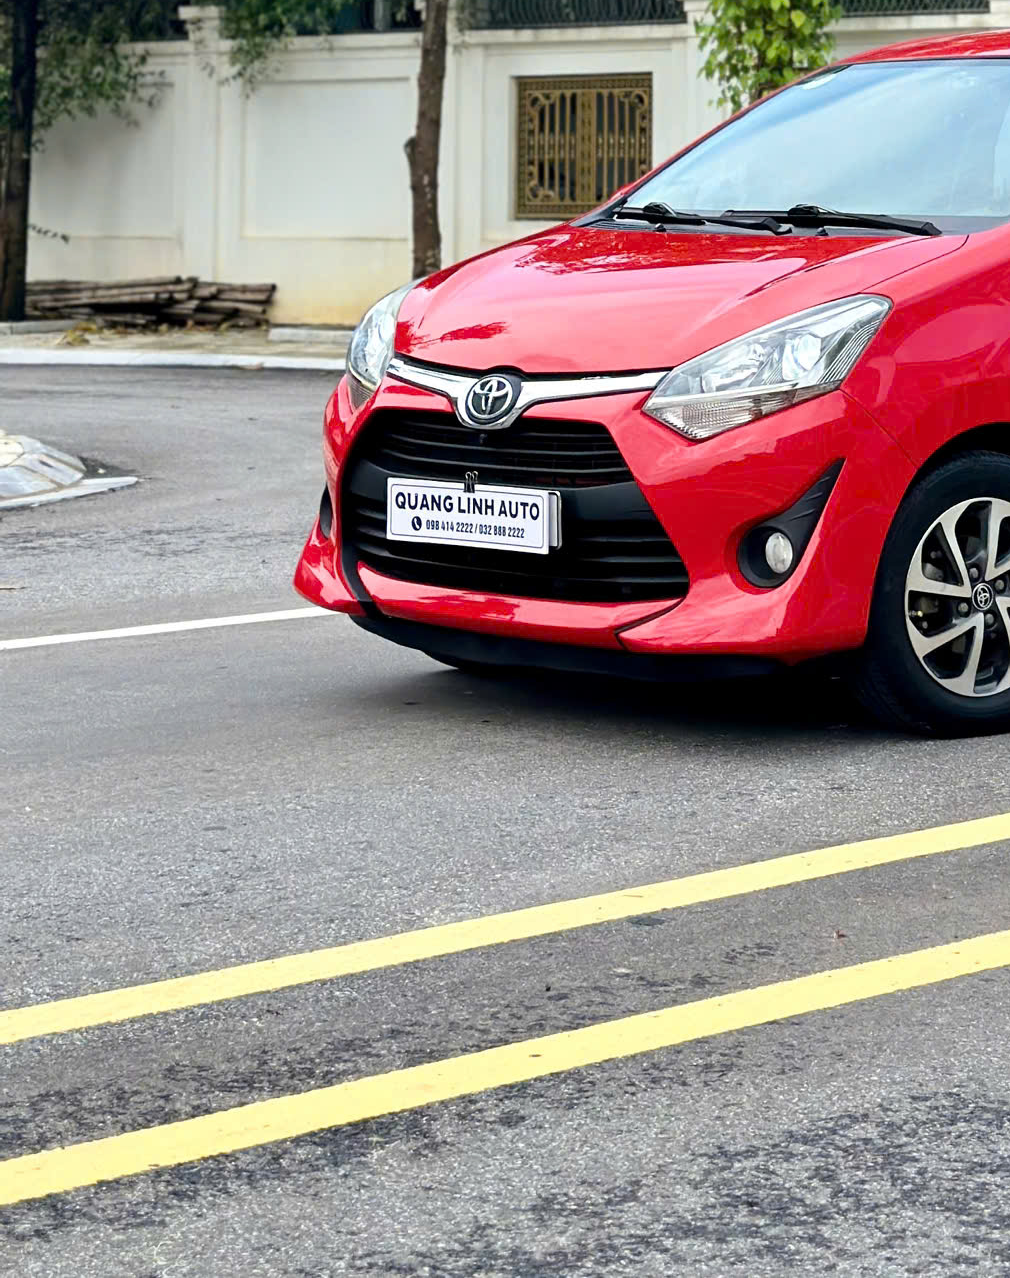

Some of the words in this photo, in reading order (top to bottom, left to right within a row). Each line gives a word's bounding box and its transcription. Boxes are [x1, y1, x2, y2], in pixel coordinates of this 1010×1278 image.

[395, 492, 454, 513] QUANG
[457, 496, 495, 516] LINH
[498, 501, 540, 521] AUTO
[441, 521, 454, 532] 414
[456, 522, 473, 533] 2222
[479, 524, 492, 536] 032
[494, 525, 506, 537] 888
[508, 527, 525, 539] 2222
